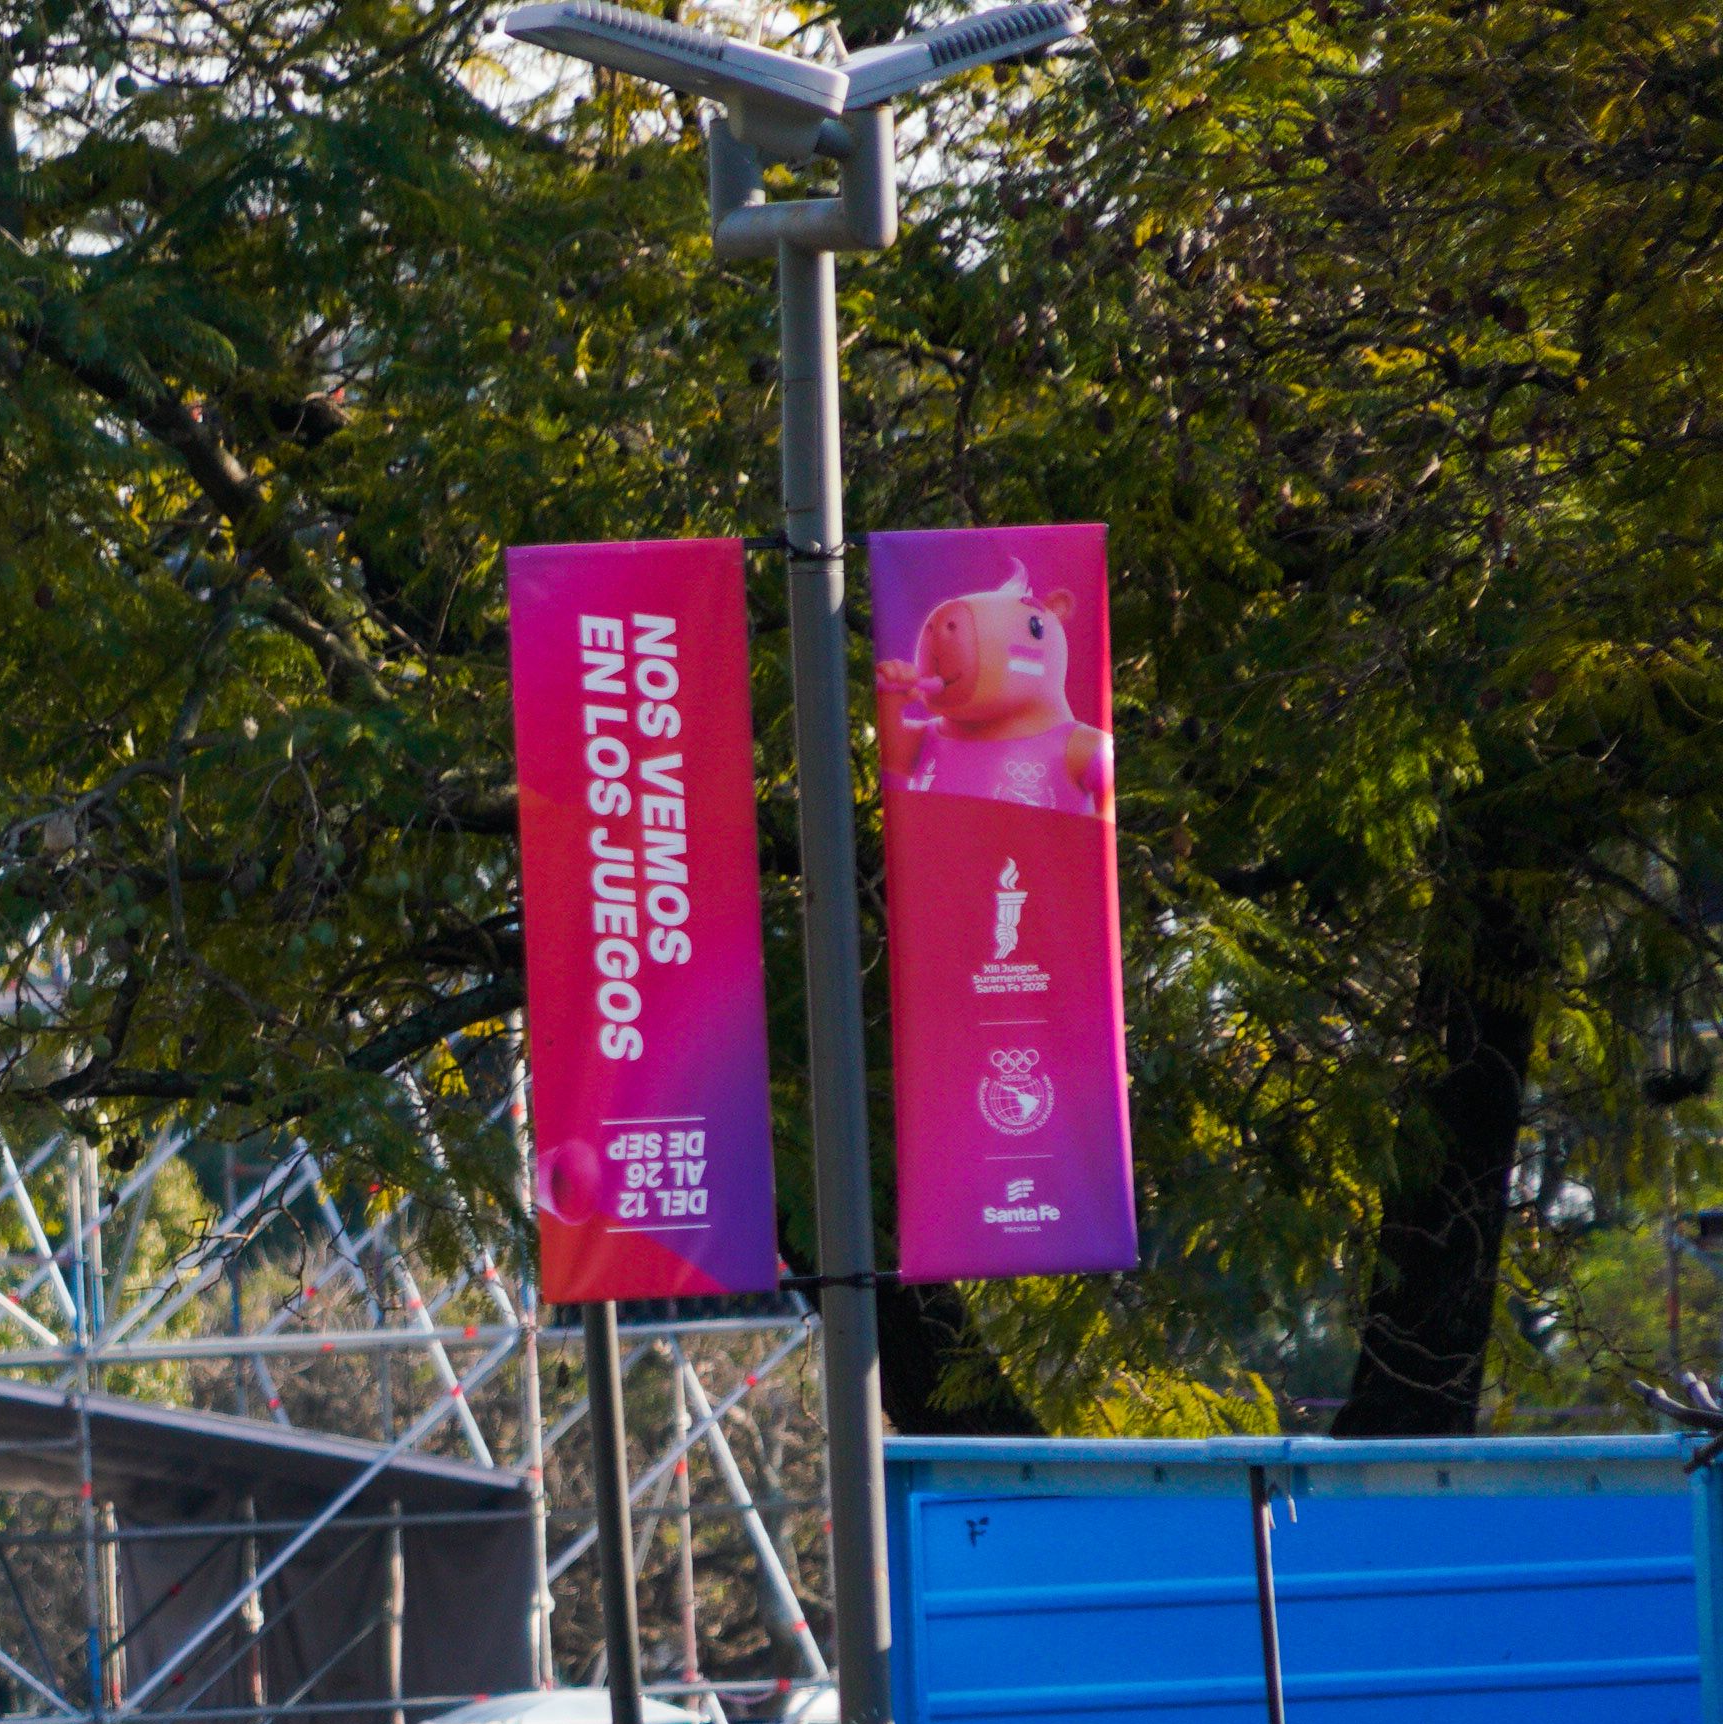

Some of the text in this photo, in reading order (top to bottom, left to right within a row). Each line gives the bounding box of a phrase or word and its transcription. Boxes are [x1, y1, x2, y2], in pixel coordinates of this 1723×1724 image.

[632, 613, 692, 965] NOS VEMOS
[579, 614, 644, 1061] EN LOS JUEGOS
[973, 974, 1051, 984] Suramericanos
[1001, 964, 1039, 974] Juegos
[976, 982, 1048, 993] Santa Fe 2026
[607, 1130, 706, 1161] DE SEP
[625, 1159, 708, 1189] AL 26
[617, 1188, 709, 1219] DEL 12
[982, 1204, 1061, 1224] Santa Fe
